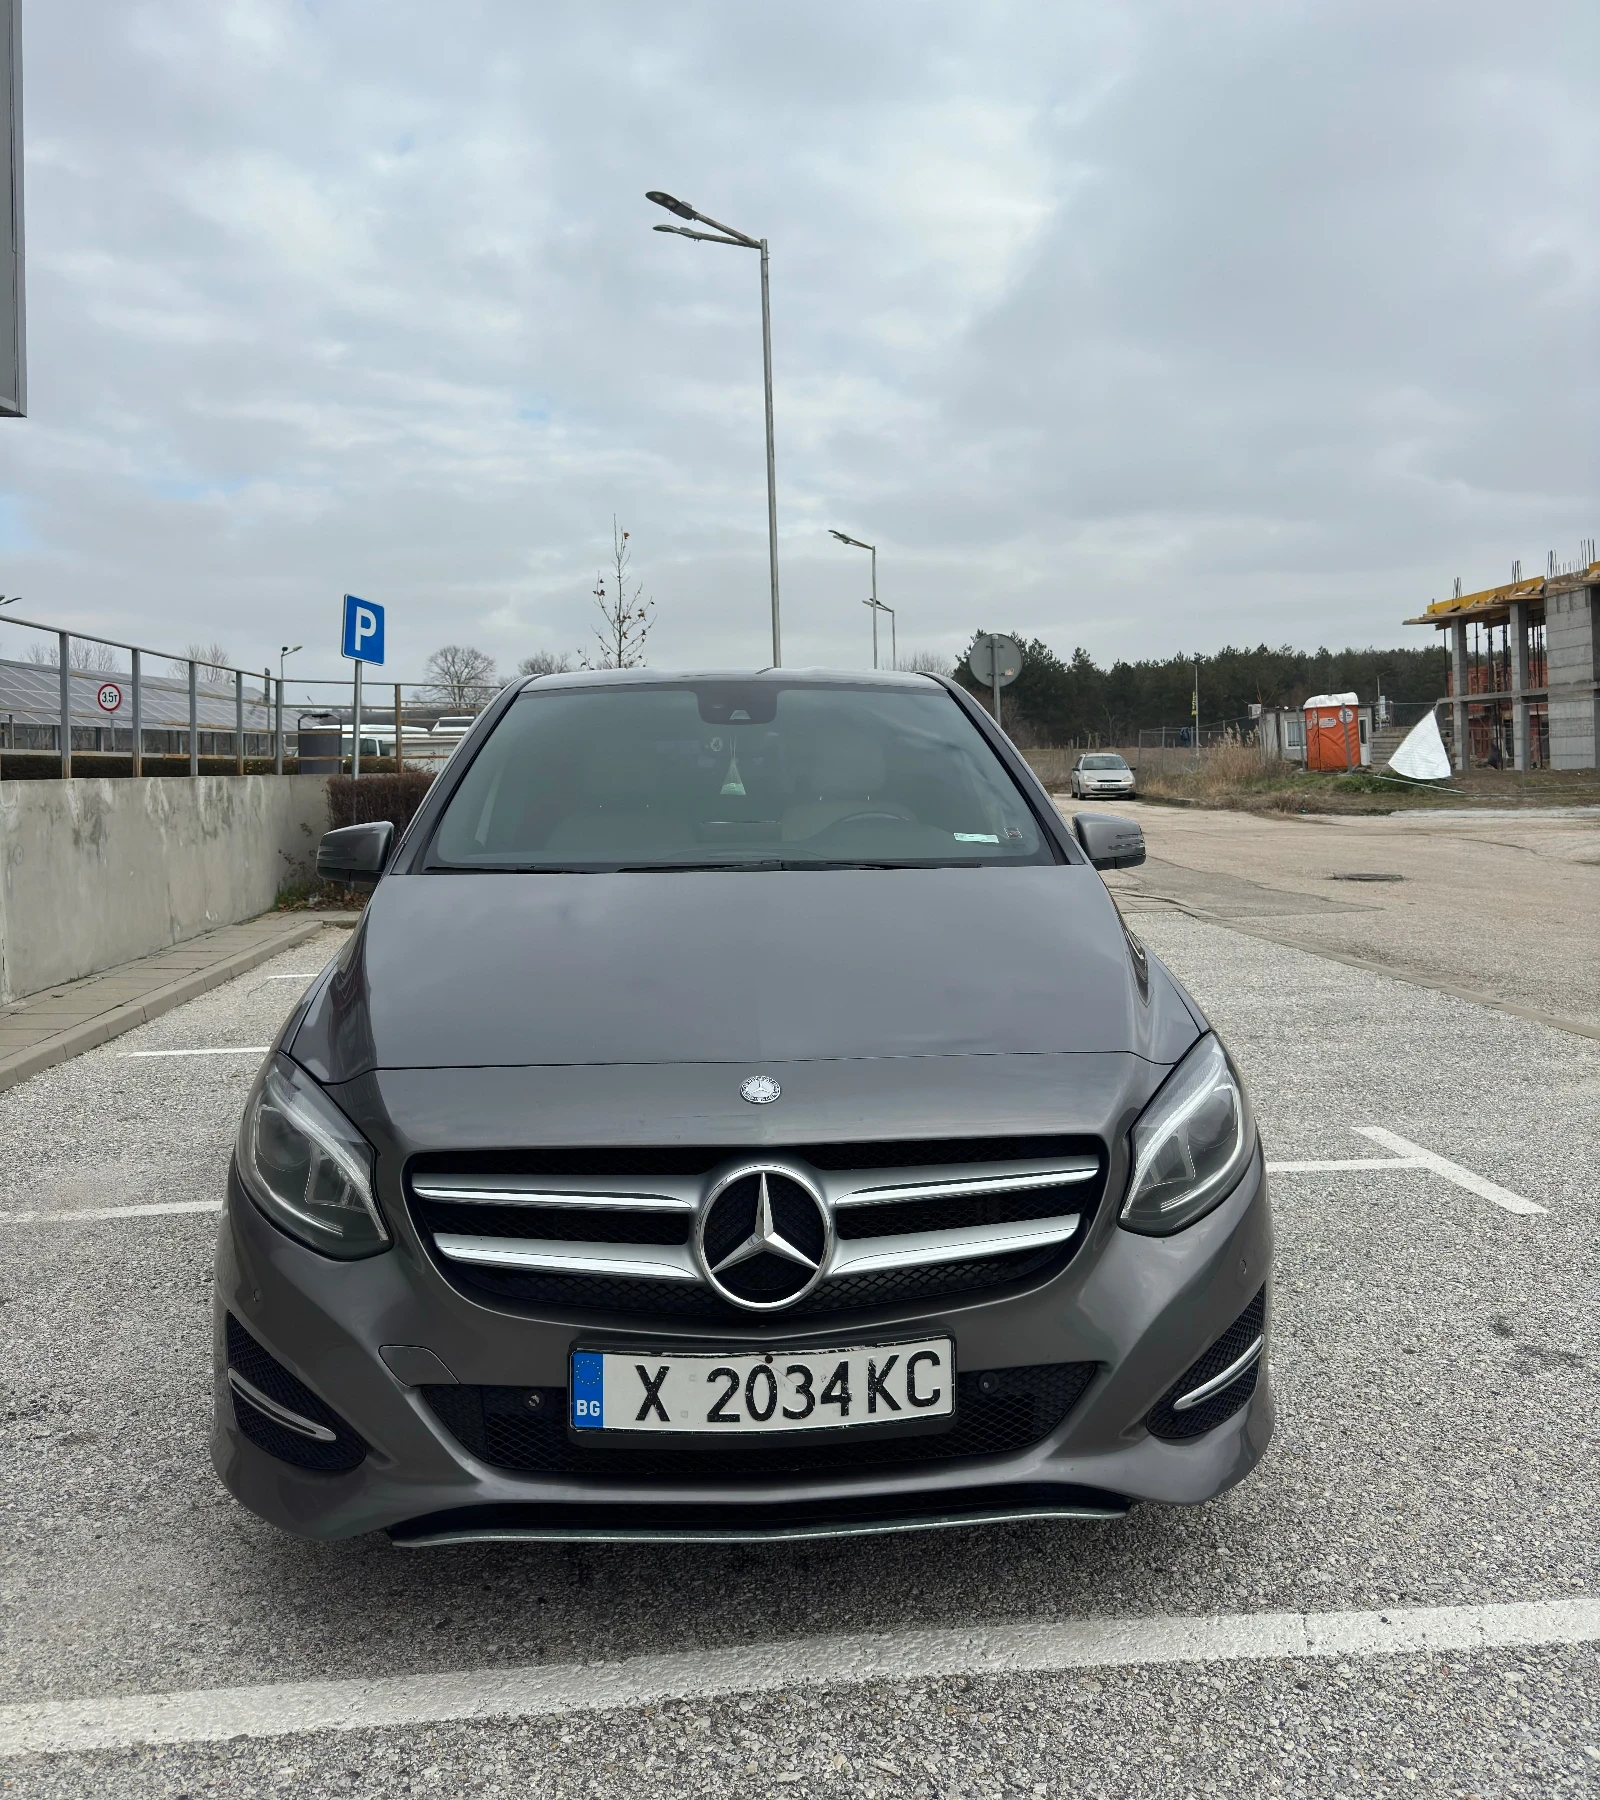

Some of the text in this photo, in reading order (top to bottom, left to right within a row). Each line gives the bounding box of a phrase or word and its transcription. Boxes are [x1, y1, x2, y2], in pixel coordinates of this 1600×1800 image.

[355, 606, 376, 651] P
[576, 1400, 600, 1416] BG
[635, 1350, 941, 1423] X 2034 KC
